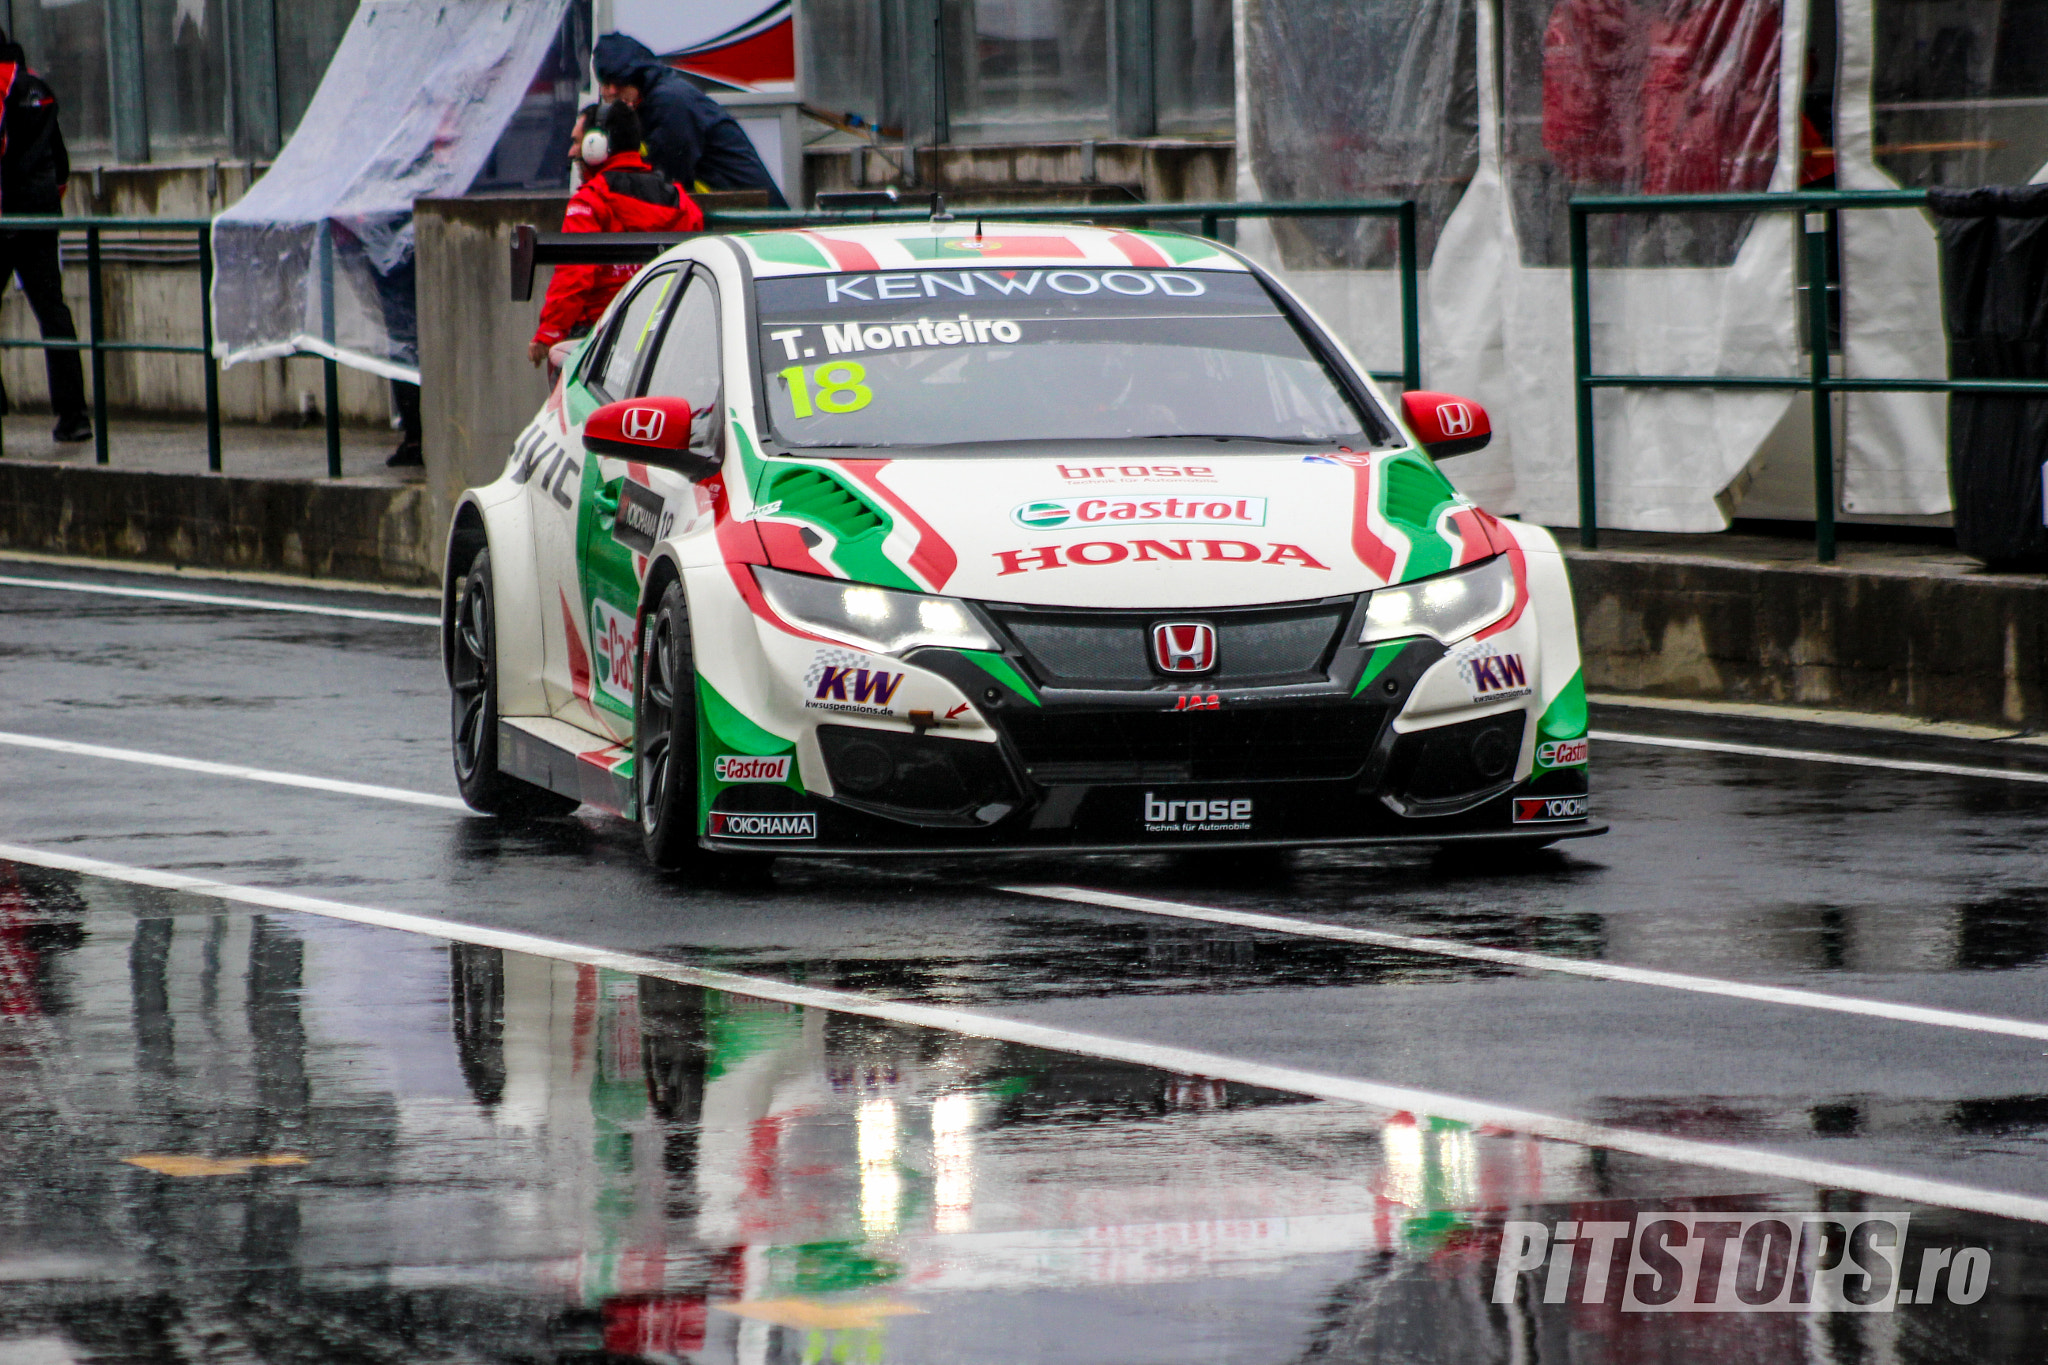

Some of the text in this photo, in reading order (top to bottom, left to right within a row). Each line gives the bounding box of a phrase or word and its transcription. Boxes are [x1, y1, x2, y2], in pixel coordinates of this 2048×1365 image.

[826, 270, 1206, 303] KENWOOD
[770, 315, 1022, 360] T. Monteiro
[776, 361, 874, 419] 18
[511, 423, 581, 511] IVIC
[1056, 464, 1215, 479] brose
[1076, 498, 1253, 522] Castrol
[992, 539, 1332, 576] HONDA
[815, 666, 905, 706] KW
[1470, 653, 1527, 693] KW
[805, 700, 894, 716] kwsuspensions.de
[726, 758, 785, 778] Castrol
[1144, 791, 1252, 822] brose
[726, 816, 812, 834] YOKOHAMA
[1144, 822, 1251, 832] Technik für Automobile
